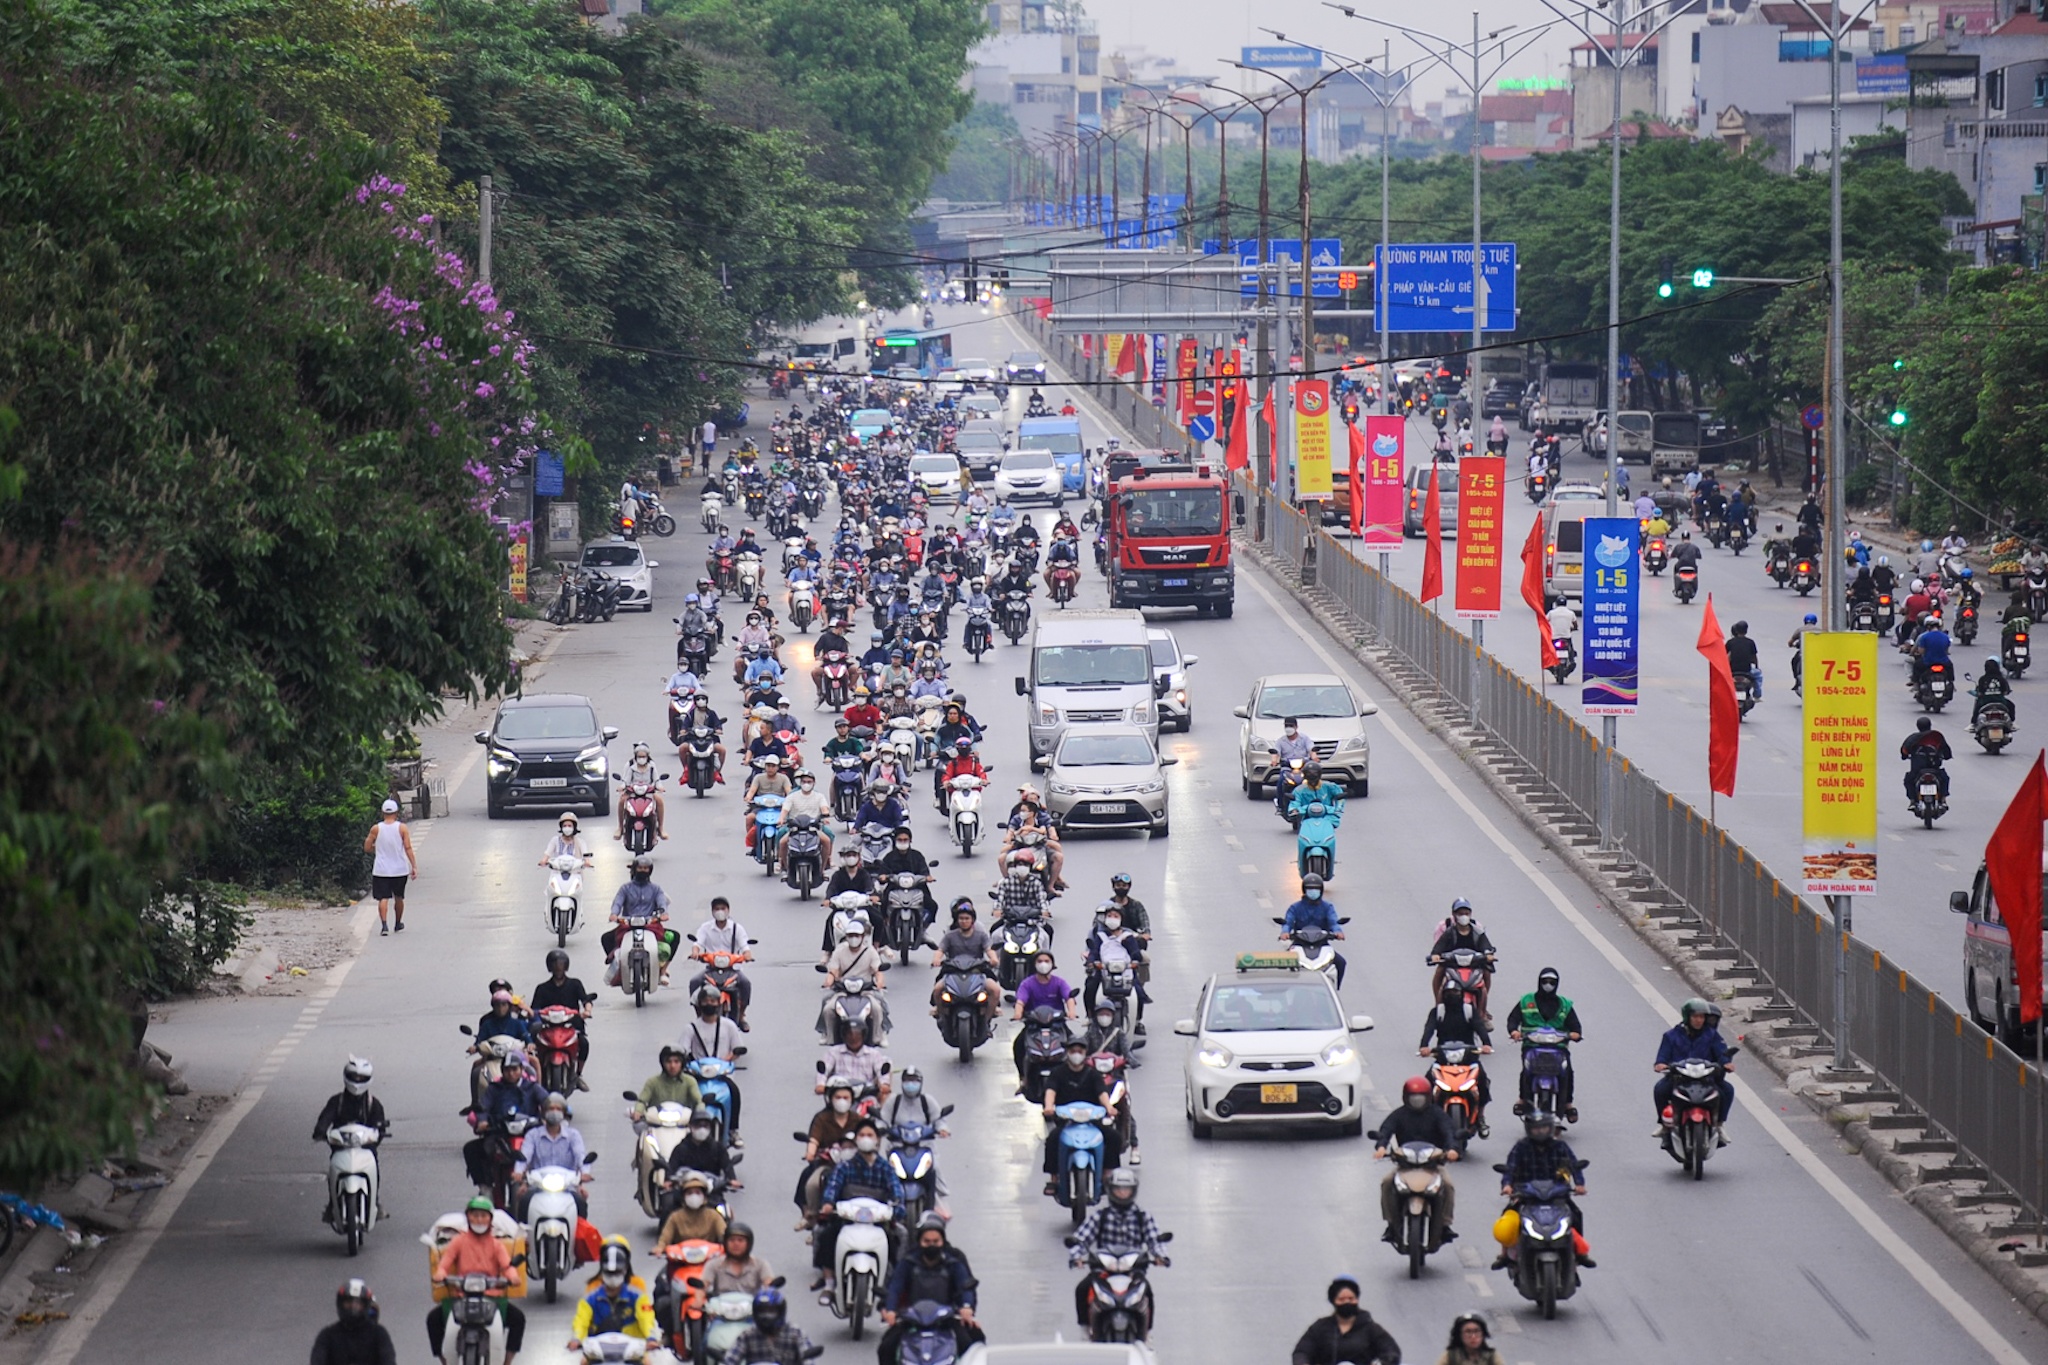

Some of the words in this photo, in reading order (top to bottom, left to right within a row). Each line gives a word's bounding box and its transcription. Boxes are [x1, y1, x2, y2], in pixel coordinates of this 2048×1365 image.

[1380, 248, 1416, 263] ƯỜNG
[1420, 250, 1447, 263] PHAN
[1489, 247, 1510, 265] TUỆ
[1485, 264, 1499, 275] km
[1693, 270, 1713, 287] 02
[1393, 280, 1415, 293] PHÁP
[1427, 296, 1440, 306] km
[1371, 459, 1399, 478] 1-5
[1469, 474, 1494, 488] 7-5
[1596, 569, 1627, 587] 1-5
[1821, 660, 1861, 681] 7-5
[1816, 687, 1866, 695] 1954-2024
[1814, 715, 1839, 726] CHIẾN
[1841, 715, 1868, 726] THẮNG
[1811, 732, 1831, 744] ĐIỆN
[1833, 730, 1852, 742] BIÊN
[1854, 729, 1871, 742] PHỦ
[1821, 746, 1843, 758] LỪNG
[1819, 761, 1838, 773] NĂM
[1840, 761, 1863, 773] CHÂU
[1817, 776, 1840, 789] CHẤN
[1841, 776, 1865, 789] ĐỘNG
[1821, 791, 1836, 804] ĐỊA
[1838, 791, 1855, 804] CẦU
[1856, 791, 1860, 804] !
[1807, 883, 1829, 892] QUẬN
[1830, 883, 1857, 892] HOÀNG
[1858, 883, 1873, 892] MAI
